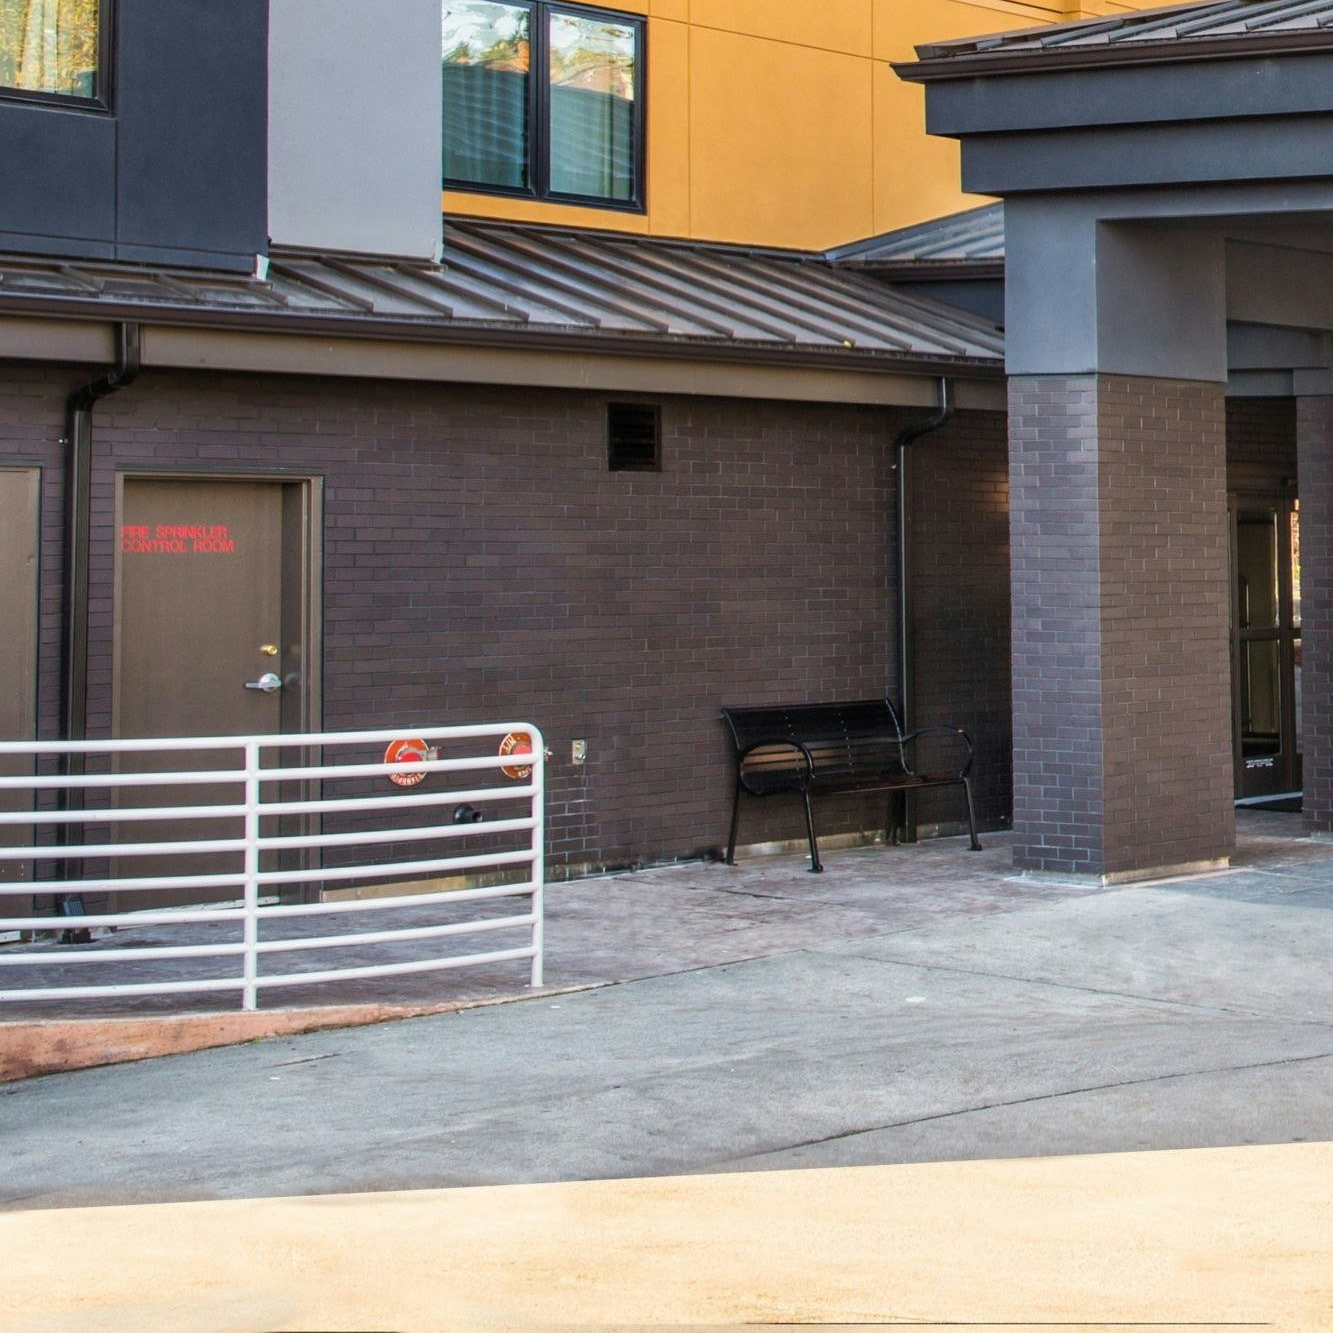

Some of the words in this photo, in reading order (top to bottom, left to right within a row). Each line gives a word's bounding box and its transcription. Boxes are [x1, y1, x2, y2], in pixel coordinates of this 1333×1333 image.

[121, 524, 149, 539] FIRE
[156, 524, 228, 539] SPRINKLER
[121, 539, 187, 553] CONTROL
[193, 539, 235, 553] ROOM
